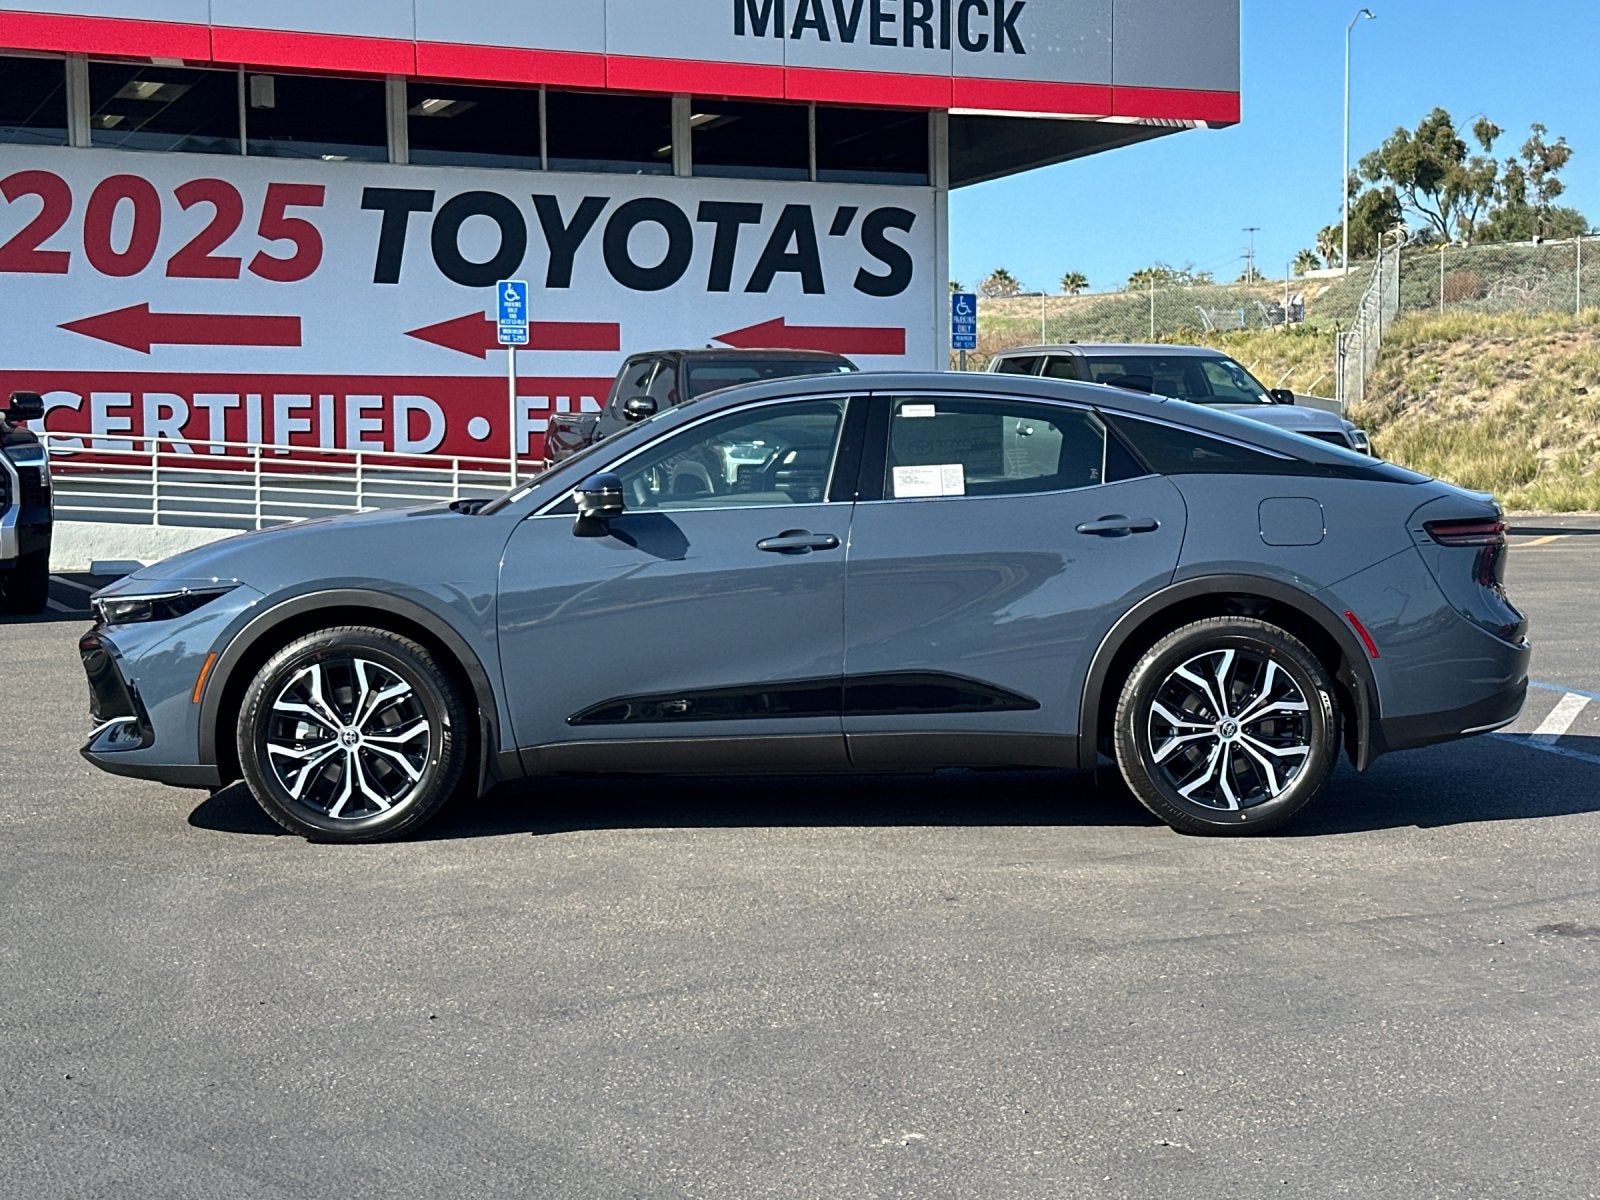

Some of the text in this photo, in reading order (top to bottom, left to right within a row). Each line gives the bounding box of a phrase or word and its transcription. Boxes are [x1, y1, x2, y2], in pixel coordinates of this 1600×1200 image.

[733, 0, 1026, 54] MAVERICK
[0, 170, 916, 297] 2025 TOYOTA'S
[953, 316, 976, 324] PARKING
[957, 324, 971, 333] ONLY
[27, 390, 447, 455] CERTIFIED
